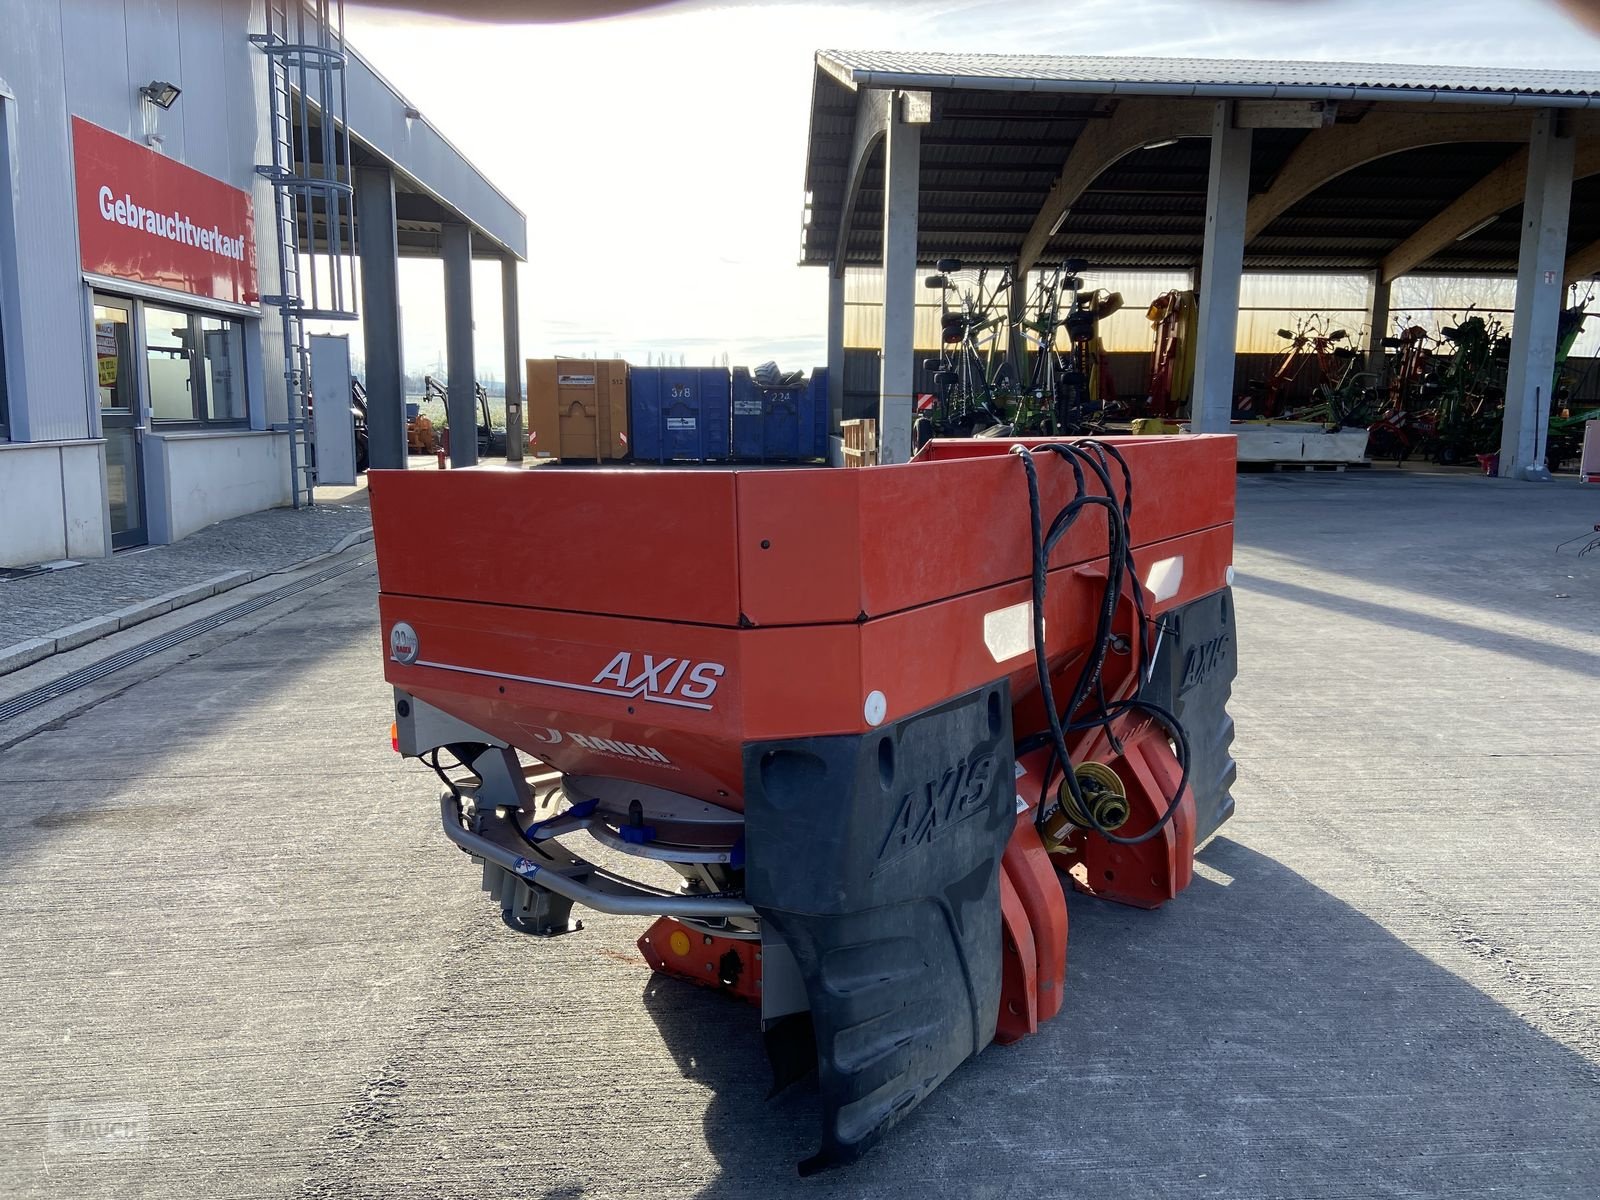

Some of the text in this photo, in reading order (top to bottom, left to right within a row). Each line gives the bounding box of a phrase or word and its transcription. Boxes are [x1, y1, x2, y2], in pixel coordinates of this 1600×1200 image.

[98, 185, 244, 261] Gebrauchtverkauf
[591, 651, 726, 699] AXIS
[1182, 632, 1229, 689] AXIS
[566, 731, 672, 764] RAUCH
[877, 752, 994, 860] AXIS
